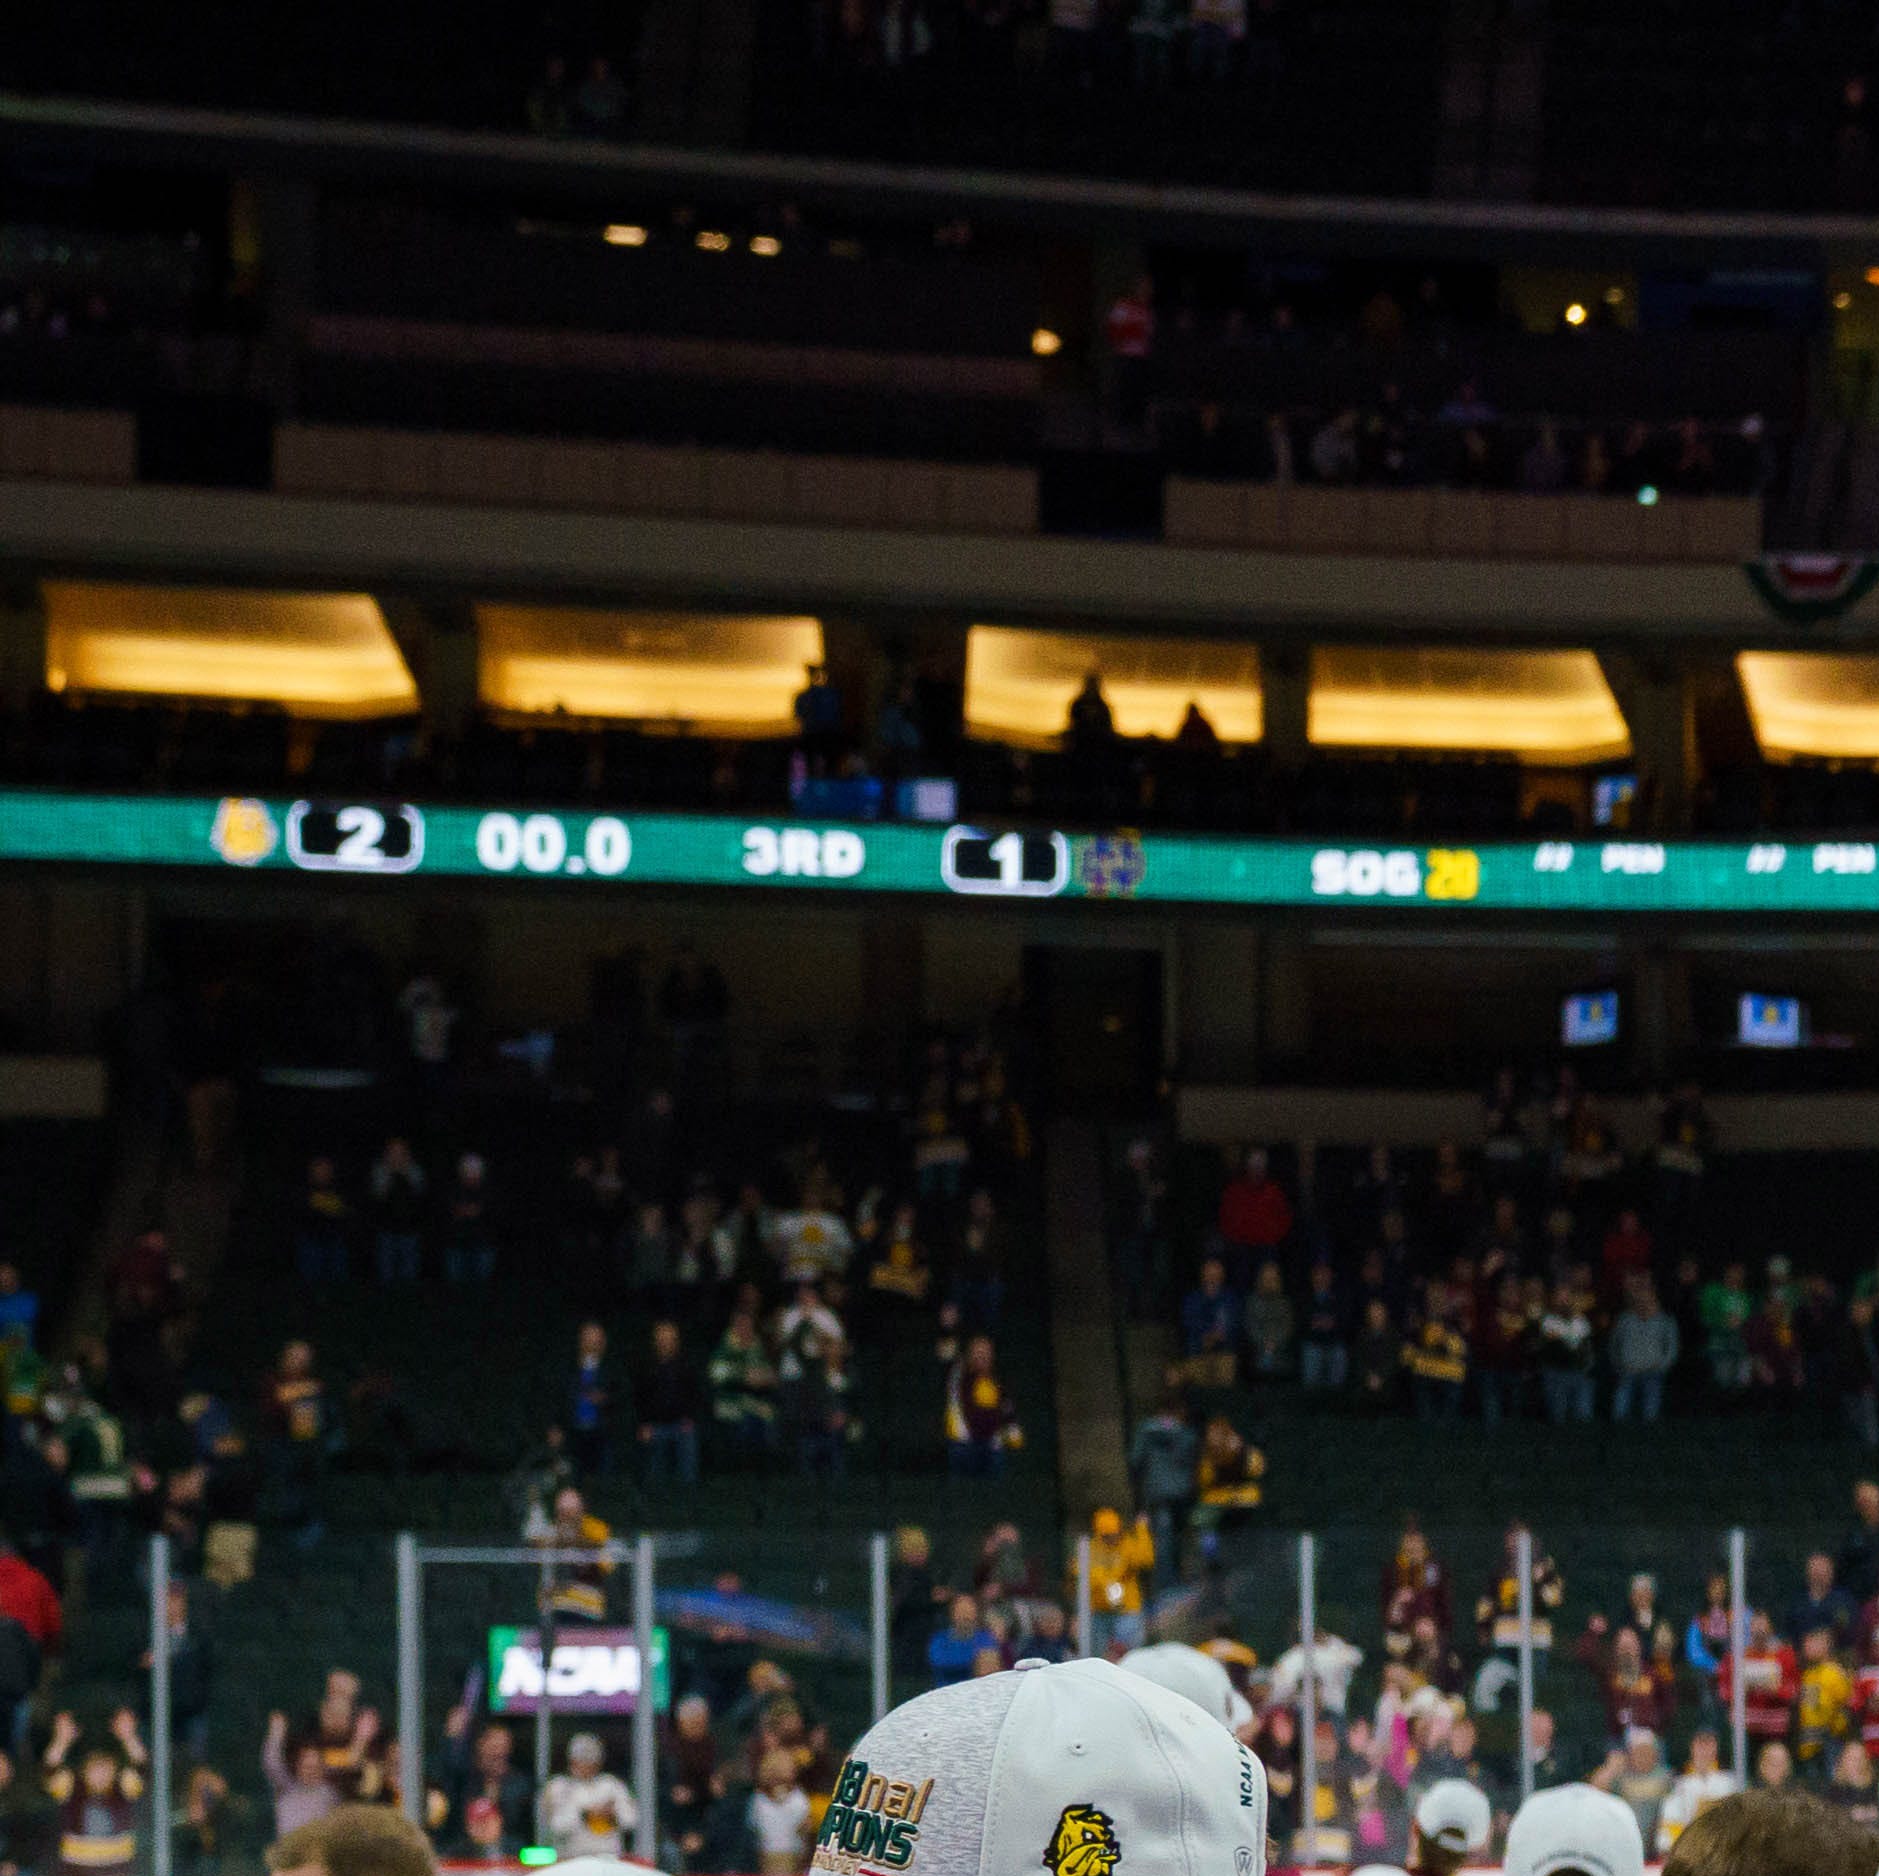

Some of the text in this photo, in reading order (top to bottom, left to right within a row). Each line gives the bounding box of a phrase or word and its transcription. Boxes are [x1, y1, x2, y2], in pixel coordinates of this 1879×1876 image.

[335, 808, 387, 863] 2
[476, 813, 631, 876] 00.0
[743, 827, 866, 879] 3RD
[989, 835, 1025, 891] 1
[1311, 848, 1420, 897] SOG
